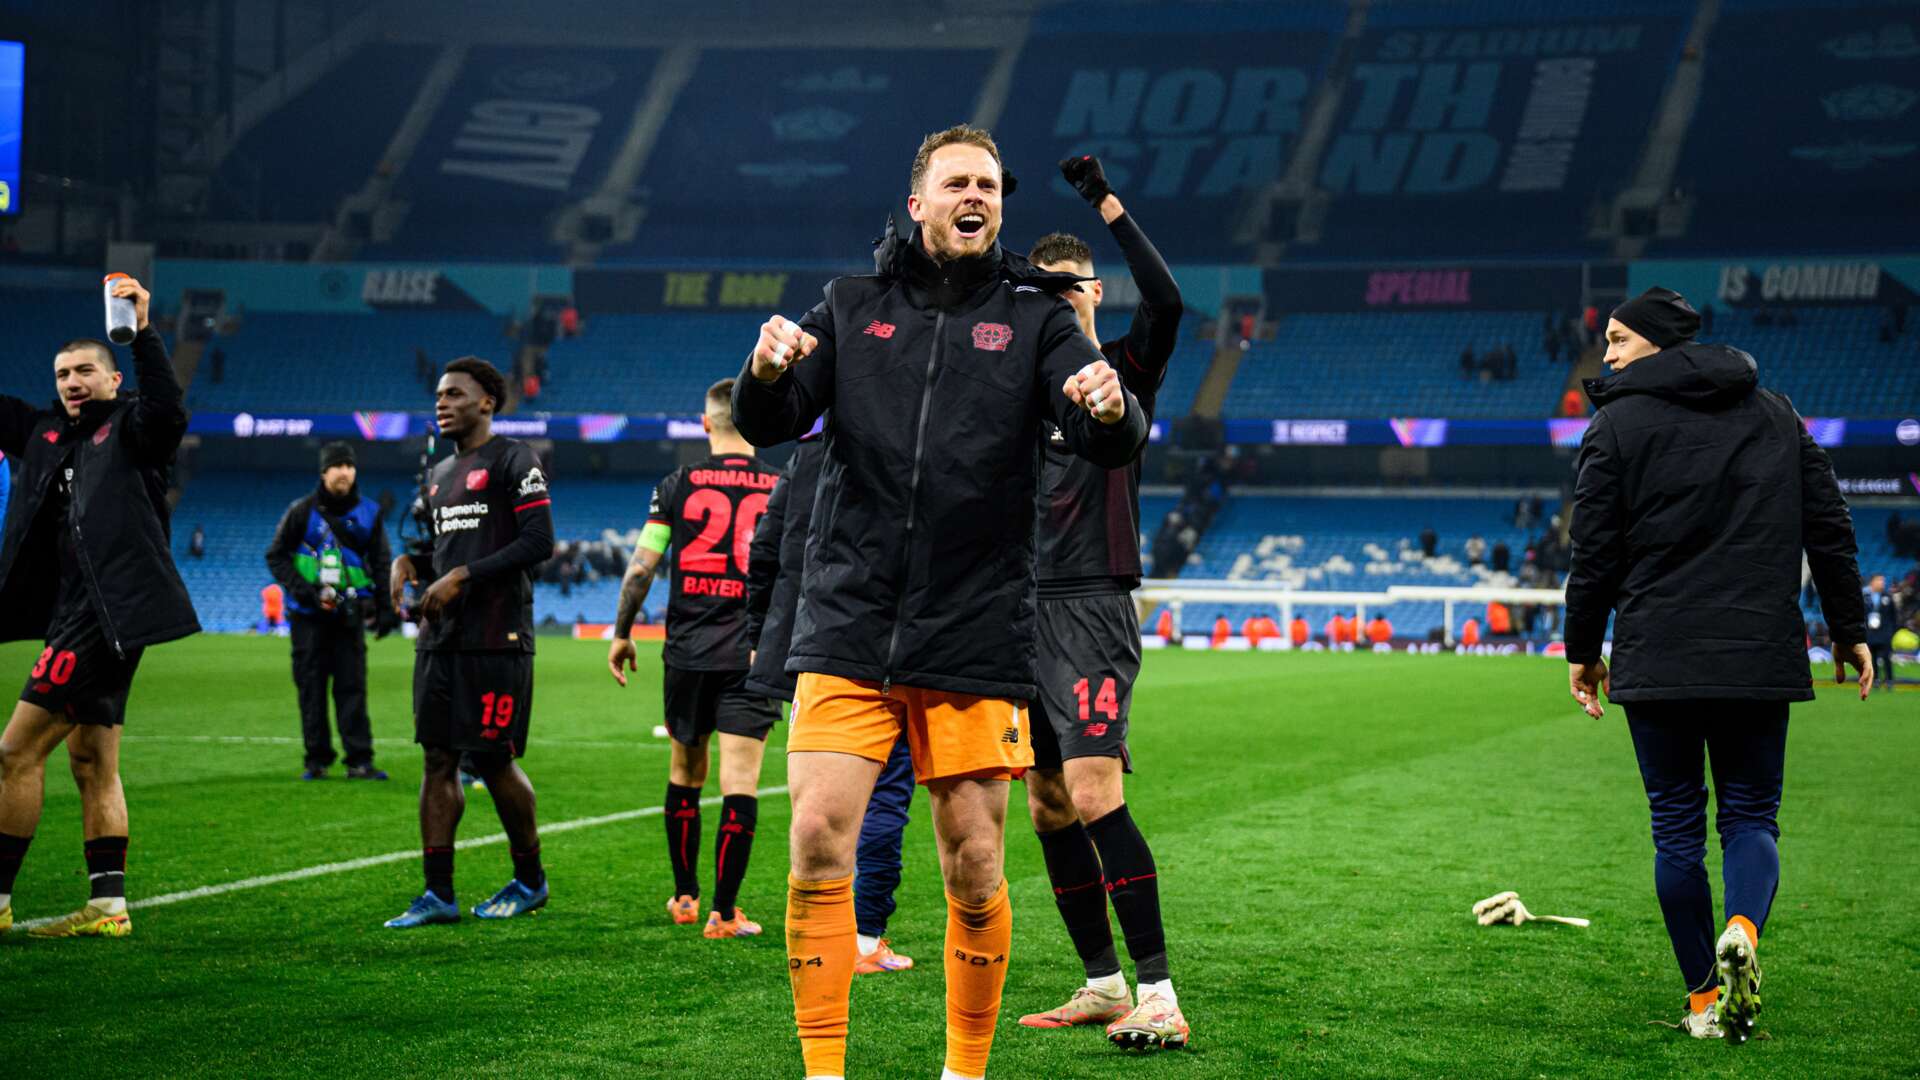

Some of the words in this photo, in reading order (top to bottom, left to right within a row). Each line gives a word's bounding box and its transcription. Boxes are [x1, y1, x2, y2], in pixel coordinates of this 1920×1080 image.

[361, 271, 439, 303] RAISE
[664, 273, 712, 306] THE
[719, 273, 789, 306] ROOF
[1366, 271, 1472, 305] SPECIAL
[1717, 265, 1748, 301] IS
[1761, 263, 1880, 300] COMING
[683, 576, 744, 597] BAYER
[481, 690, 513, 727] 19
[1073, 677, 1119, 720] 14
[789, 956, 823, 969] 04
